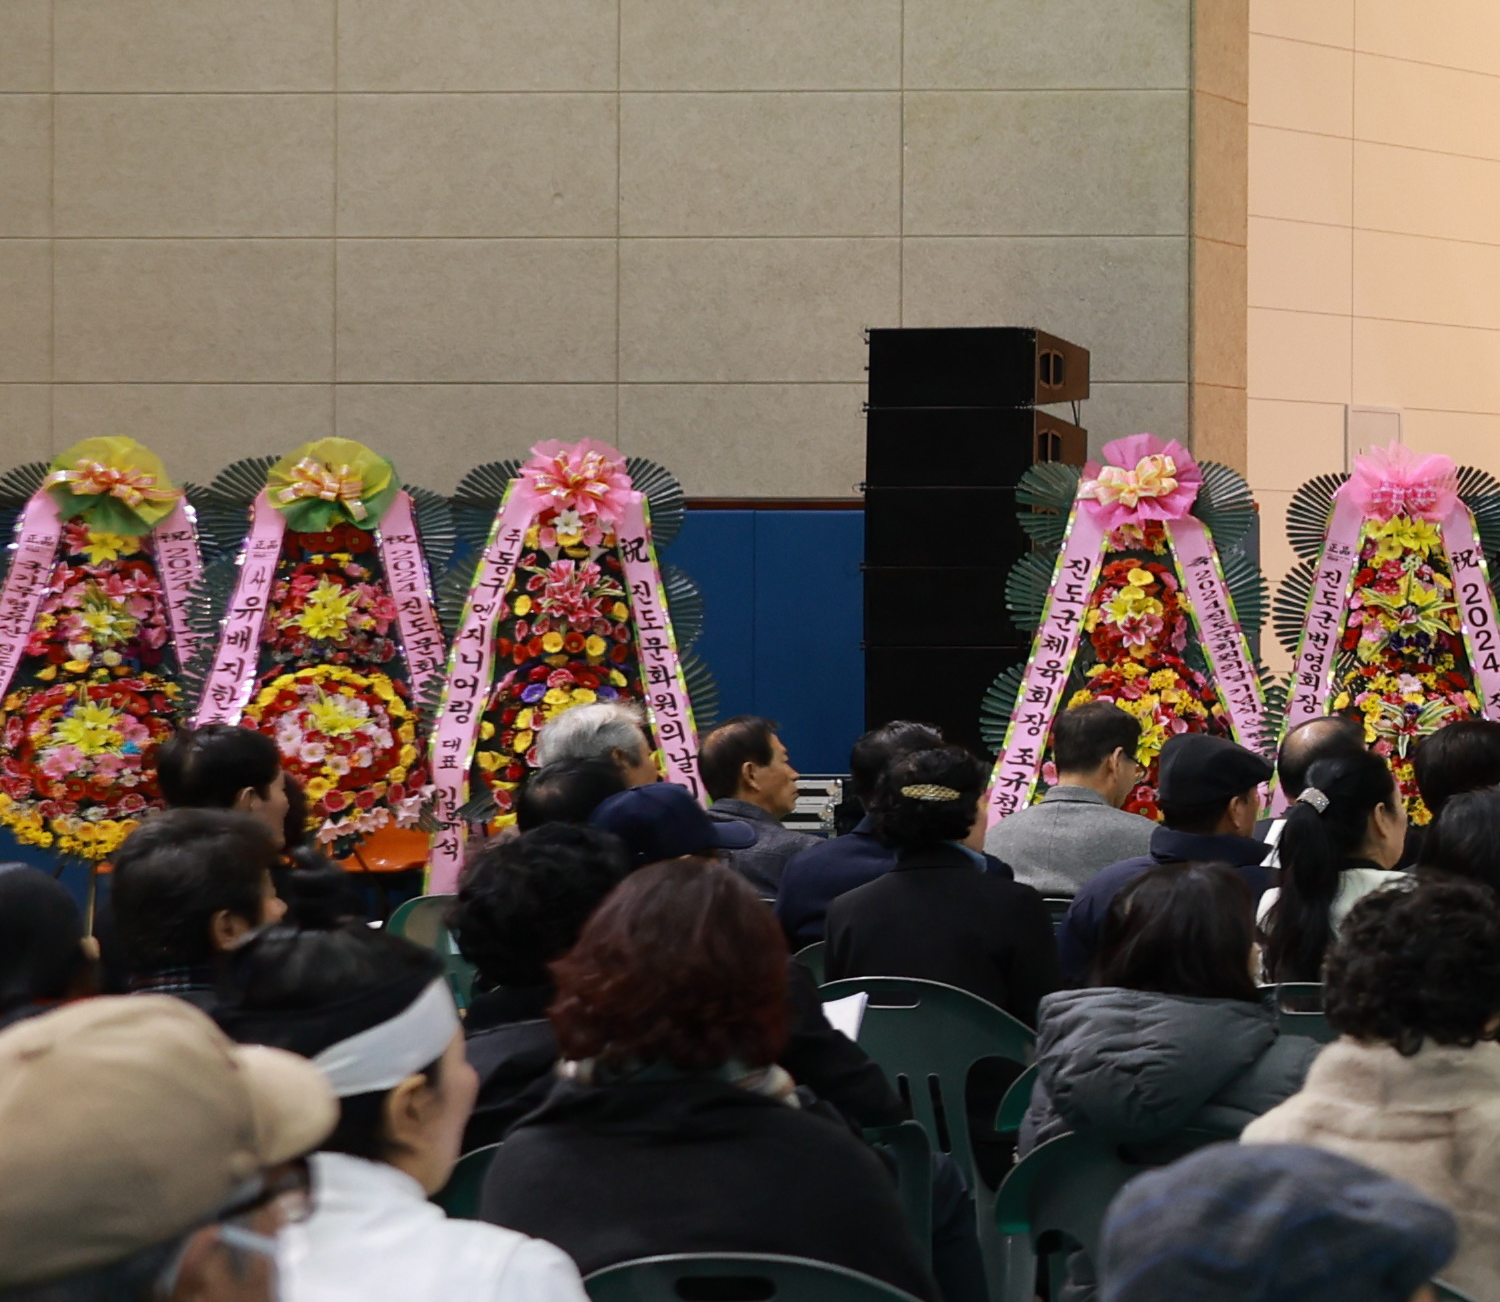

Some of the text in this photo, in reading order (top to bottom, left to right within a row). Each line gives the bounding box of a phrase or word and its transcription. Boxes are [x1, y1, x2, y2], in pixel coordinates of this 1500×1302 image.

[621, 537, 650, 563] 祝
[1451, 549, 1479, 572] 祝
[1017, 557, 1091, 736] 진도군체육회장
[1295, 569, 1342, 714] 진도군번영회장
[1461, 583, 1500, 674] 2024
[438, 738, 462, 770] 대표
